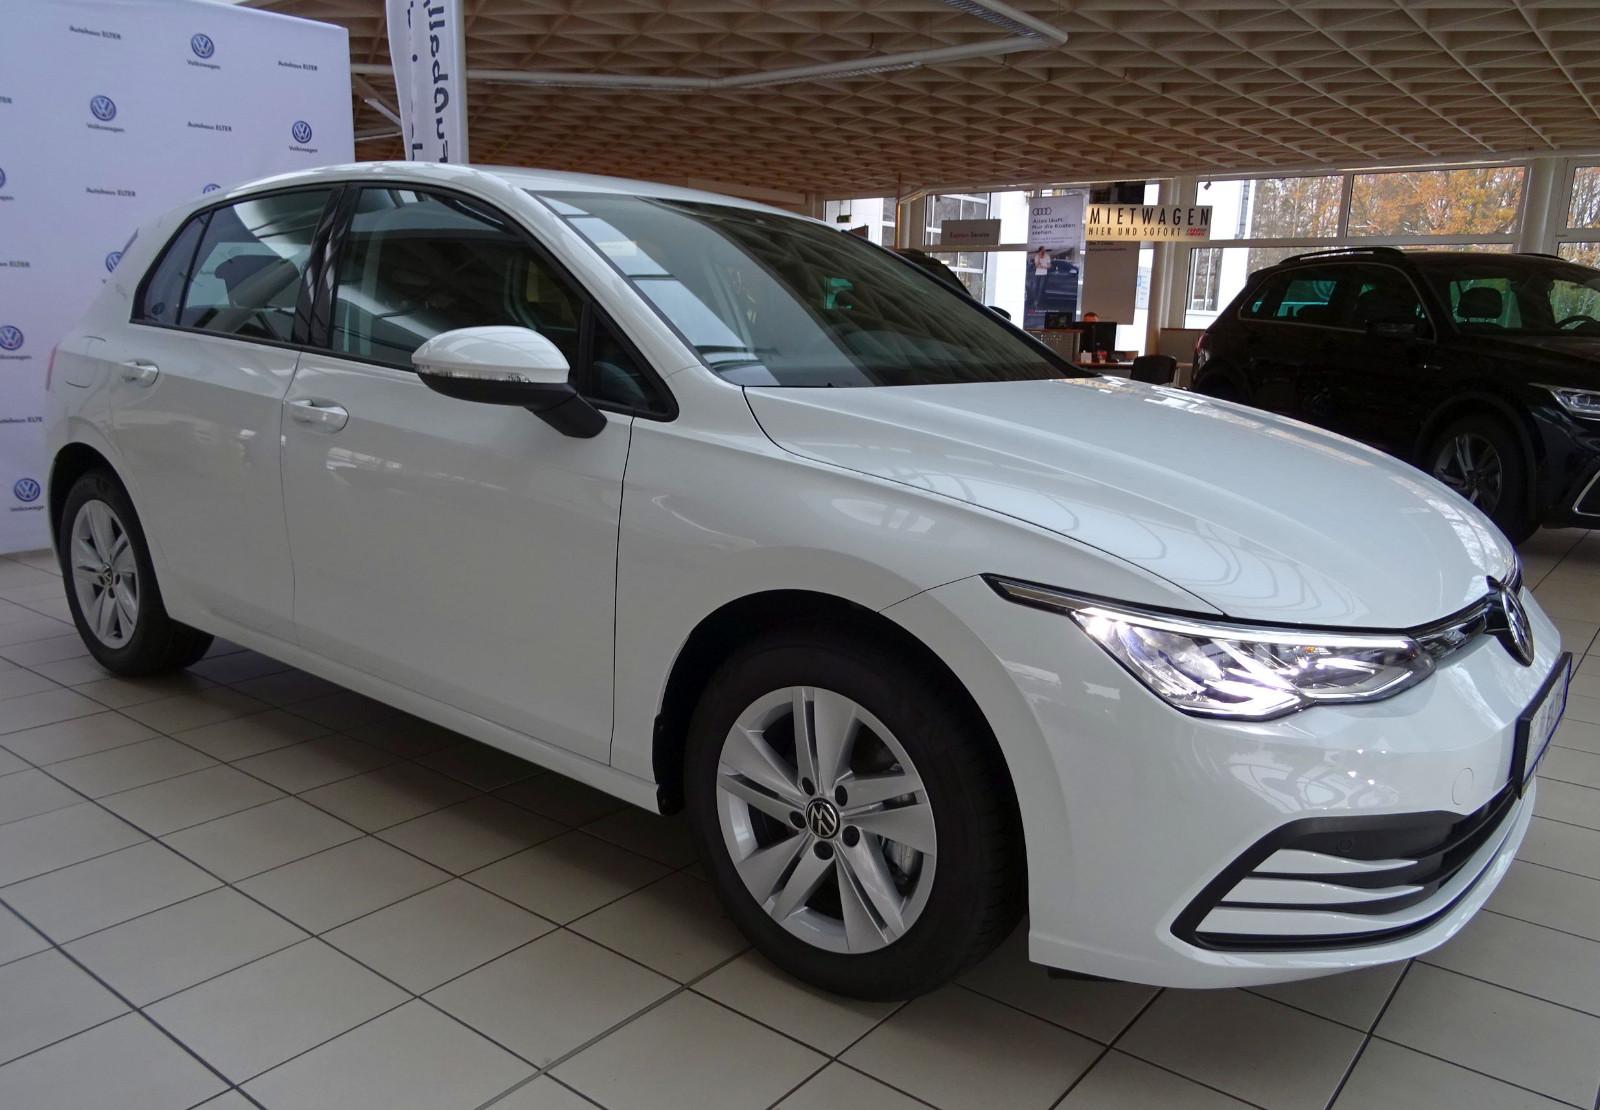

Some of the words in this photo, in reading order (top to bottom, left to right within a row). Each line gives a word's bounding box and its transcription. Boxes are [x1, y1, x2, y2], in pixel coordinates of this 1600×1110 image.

[69, 25, 100, 37] Autohaus
[102, 30, 121, 40] ELTER
[187, 59, 221, 69] Volkswagen
[278, 60, 302, 69] Autohaus
[303, 63, 318, 71] ELTER
[86, 122, 125, 132] Volkswagen
[188, 121, 215, 129] Autohaus
[215, 124, 232, 132] ELTER
[289, 145, 318, 153] Volkswagen
[86, 187, 116, 196] Autohaus
[117, 189, 136, 197] ELTER
[1089, 207, 1209, 226] MIETWAGEN
[1088, 227, 1112, 236] HIER
[1118, 227, 1137, 236] UND
[1143, 227, 1181, 237] SOFORT
